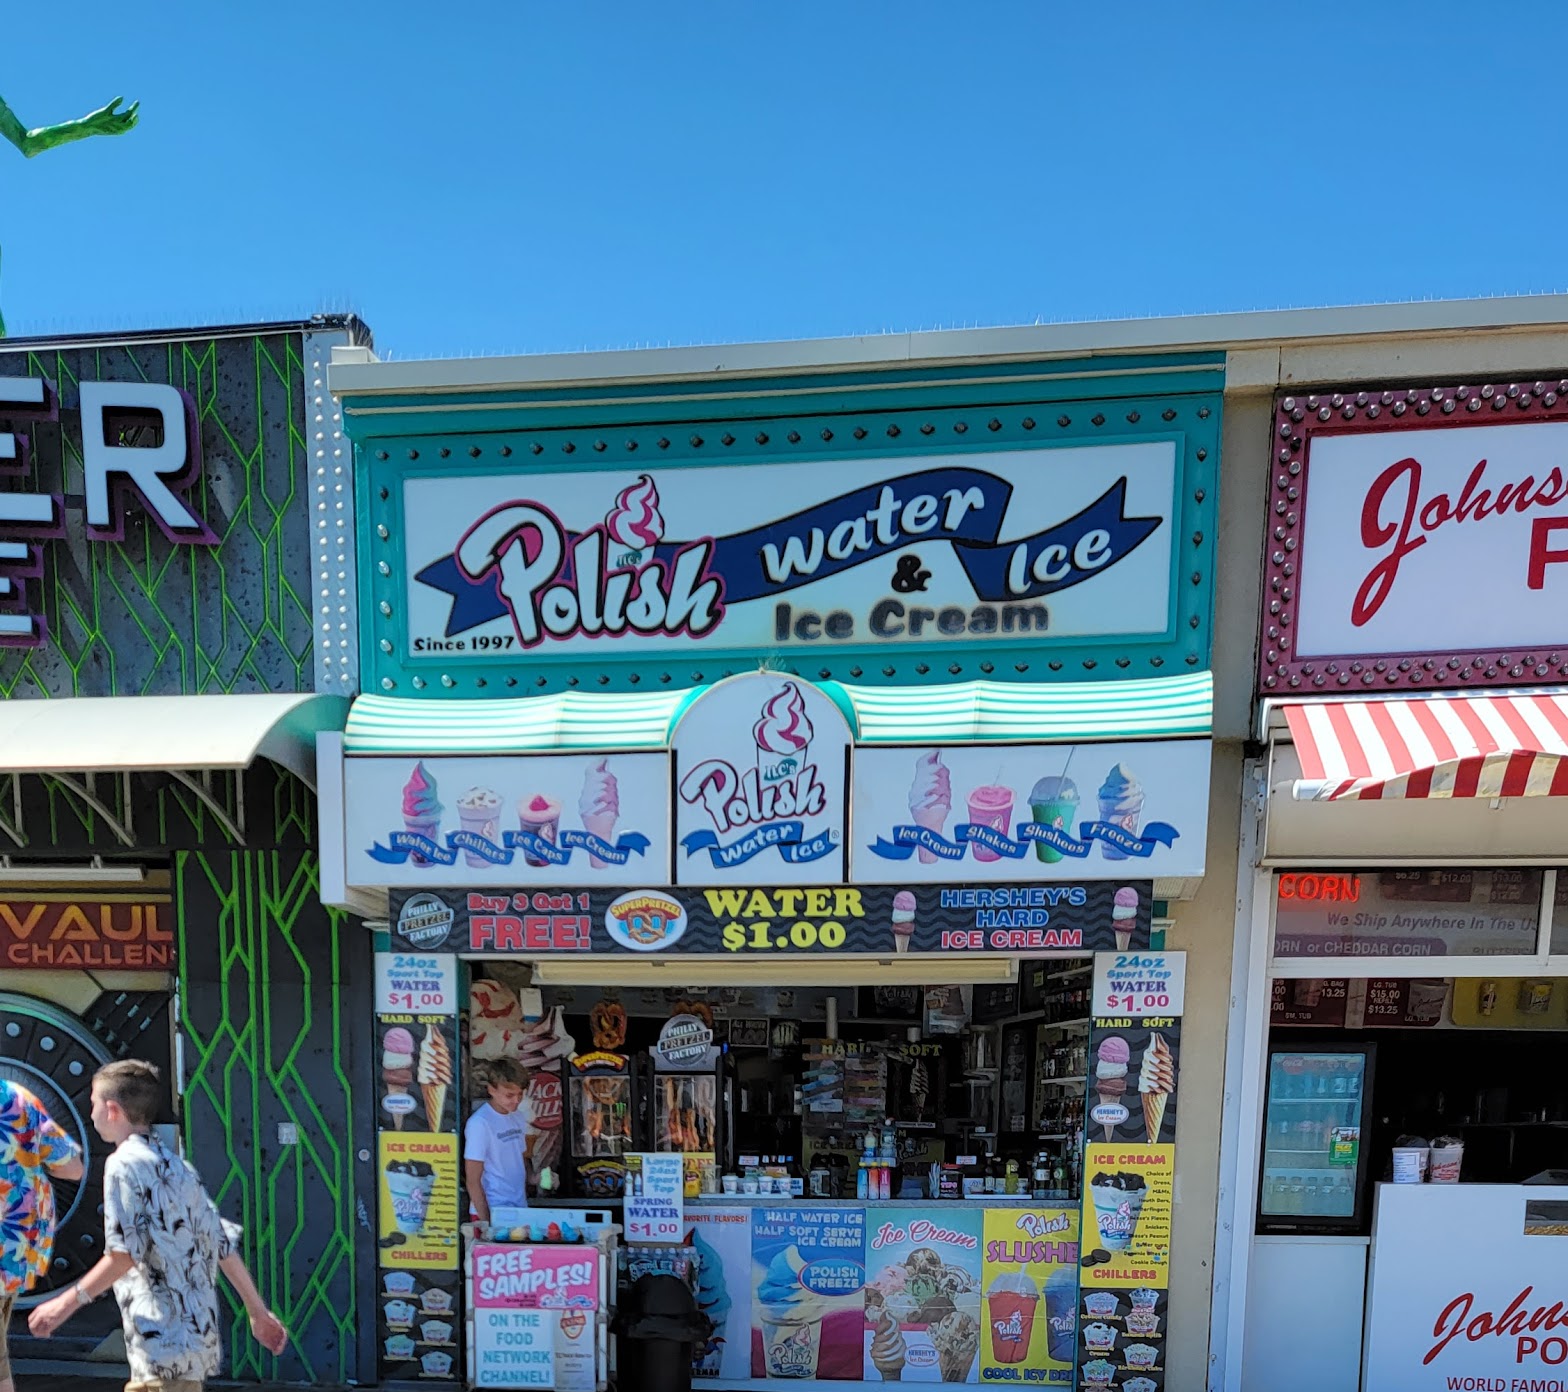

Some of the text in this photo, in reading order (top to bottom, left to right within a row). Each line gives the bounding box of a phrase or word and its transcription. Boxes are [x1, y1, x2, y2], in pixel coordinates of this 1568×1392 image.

[1351, 457, 1568, 627] Johns
[455, 485, 1112, 649] Polish water Ice
[893, 555, 929, 594] &
[775, 598, 1049, 642] Ice Cream
[413, 635, 515, 651] Since 1997
[680, 758, 827, 833] Polish
[512, 832, 531, 846] Ice
[898, 825, 961, 857] Ice Cream
[966, 824, 1016, 854] Shakes
[1090, 823, 1143, 852] Freeze
[565, 832, 625, 862] Ice Cream
[790, 839, 825, 860] Ice
[1280, 873, 1360, 903] CORN
[467, 893, 510, 913] Buy
[577, 893, 590, 911] 1
[704, 888, 864, 918] WATER
[940, 887, 1086, 908] HERSHEY'S
[408, 901, 439, 917] PHILLY
[0, 904, 173, 940] VAUL
[976, 909, 1049, 928] HARD
[1328, 912, 1348, 926] We
[1354, 912, 1387, 929] Ship
[1391, 914, 1465, 931] Anywhere
[1470, 916, 1484, 929] In
[1490, 917, 1515, 930] The
[469, 915, 591, 949] FREE!
[723, 921, 846, 951] $1.00
[942, 928, 1082, 949] ICE CREAM
[7, 943, 175, 964] CHALLEN
[1307, 944, 1319, 953] or
[1324, 942, 1389, 954] CHEDDAR
[1392, 943, 1431, 955] CORN
[394, 955, 437, 968] 24oz
[1115, 955, 1165, 968] 24oz
[1106, 970, 1171, 980] Sport Top
[390, 980, 441, 991] WATER
[1110, 981, 1167, 993] WATER
[388, 993, 443, 1009] $1.00
[1106, 994, 1169, 1013] $1.00
[381, 1014, 446, 1025] HARD SOFT
[1096, 1017, 1174, 1028] HARD SOFT
[667, 1023, 698, 1037] PHILLY
[899, 1044, 942, 1056] SOFT
[387, 1143, 451, 1153] ICE CREAM
[1093, 1155, 1166, 1165] ICE CREAM
[627, 1208, 679, 1219] WATER
[766, 1212, 863, 1224] HALF WATER ICE
[630, 1223, 678, 1237] $1.00
[754, 1225, 862, 1237] HALF SOFT SERVE
[1016, 1213, 1070, 1238] Polish
[797, 1236, 861, 1247] ICE CREAM
[872, 1220, 978, 1250] Ice Cream
[391, 1251, 448, 1261] CHILLERS
[477, 1248, 534, 1277] FREE
[810, 1266, 858, 1278] POLISH
[1093, 1269, 1157, 1280] CHILLERS
[479, 1261, 593, 1300] SAMPLES!
[809, 1278, 859, 1289] FREEZE
[489, 1314, 540, 1327] ON THE
[1423, 1286, 1568, 1365] John
[496, 1332, 533, 1345] FOOD
[483, 1350, 551, 1364] NETWORK
[1516, 1336, 1568, 1365] PO
[983, 1368, 1022, 1380] COOL
[1024, 1368, 1048, 1380] ICY
[1447, 1377, 1506, 1392] WORLD
